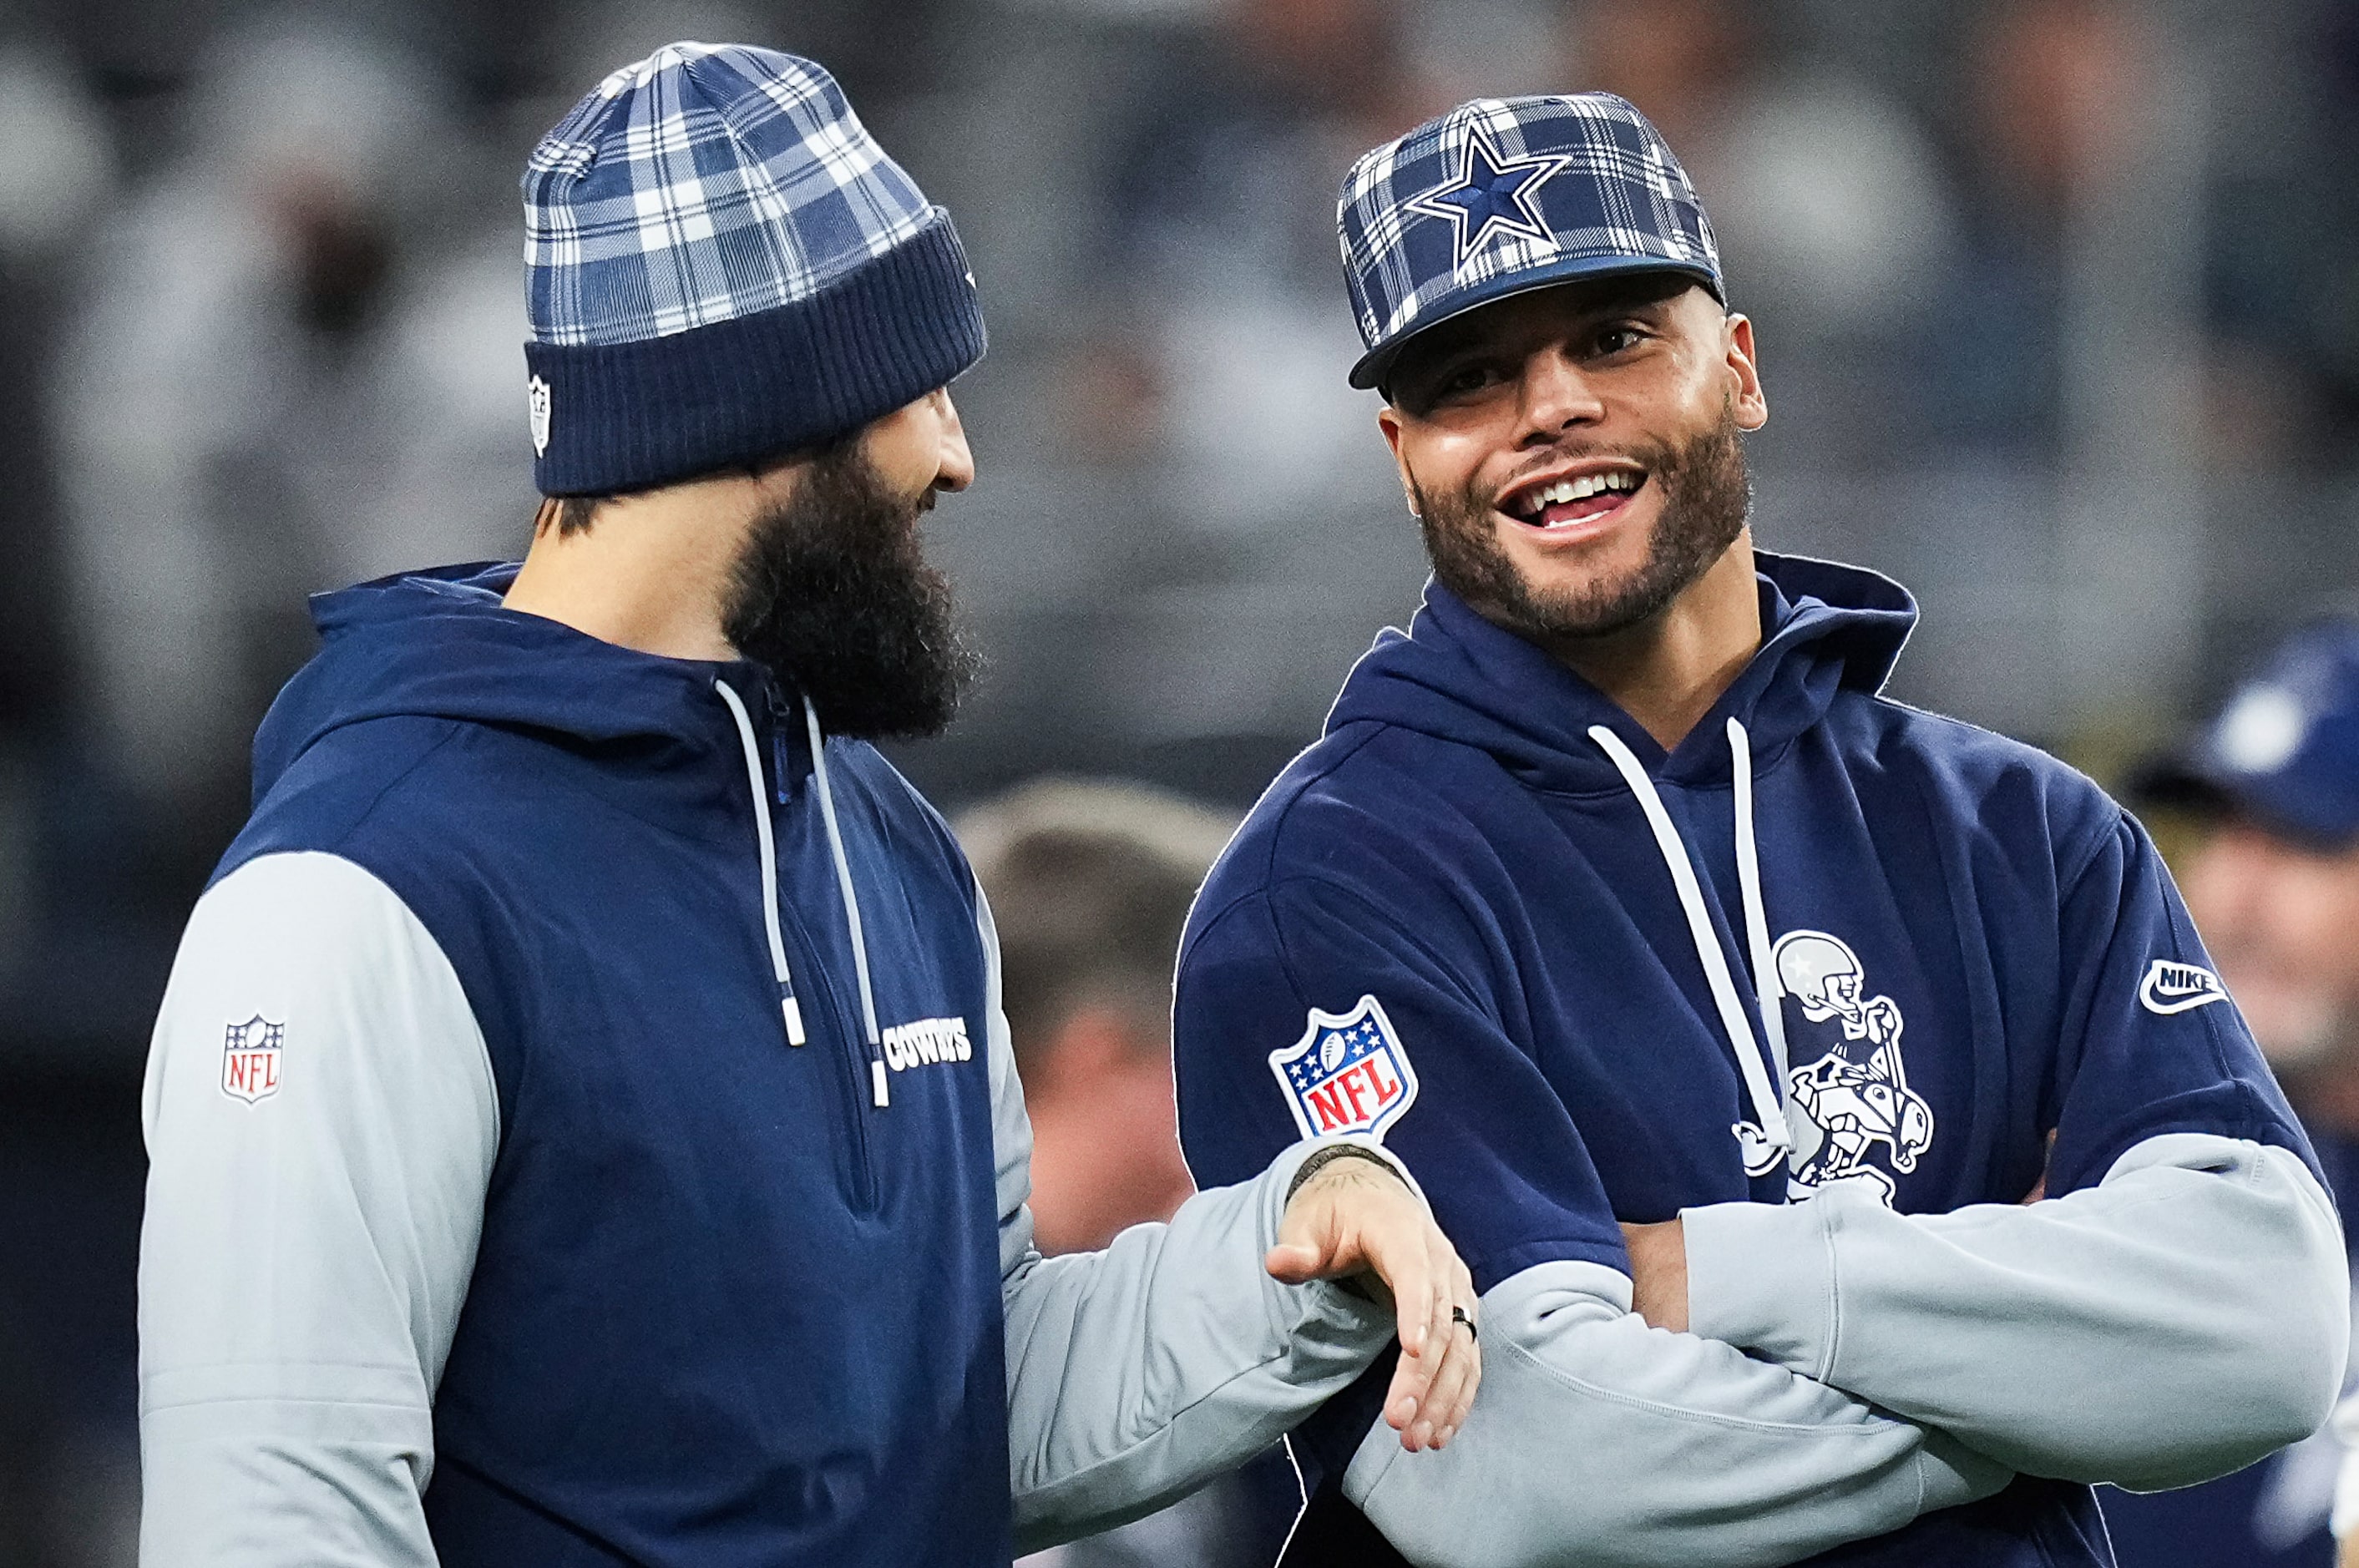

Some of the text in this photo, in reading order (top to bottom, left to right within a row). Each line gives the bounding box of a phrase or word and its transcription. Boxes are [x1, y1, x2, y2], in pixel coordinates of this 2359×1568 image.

[2159, 967, 2211, 990] NIKE
[882, 1016, 972, 1072] COWBYS
[229, 1054, 278, 1093] NFL
[1308, 1058, 1399, 1132] NFL
